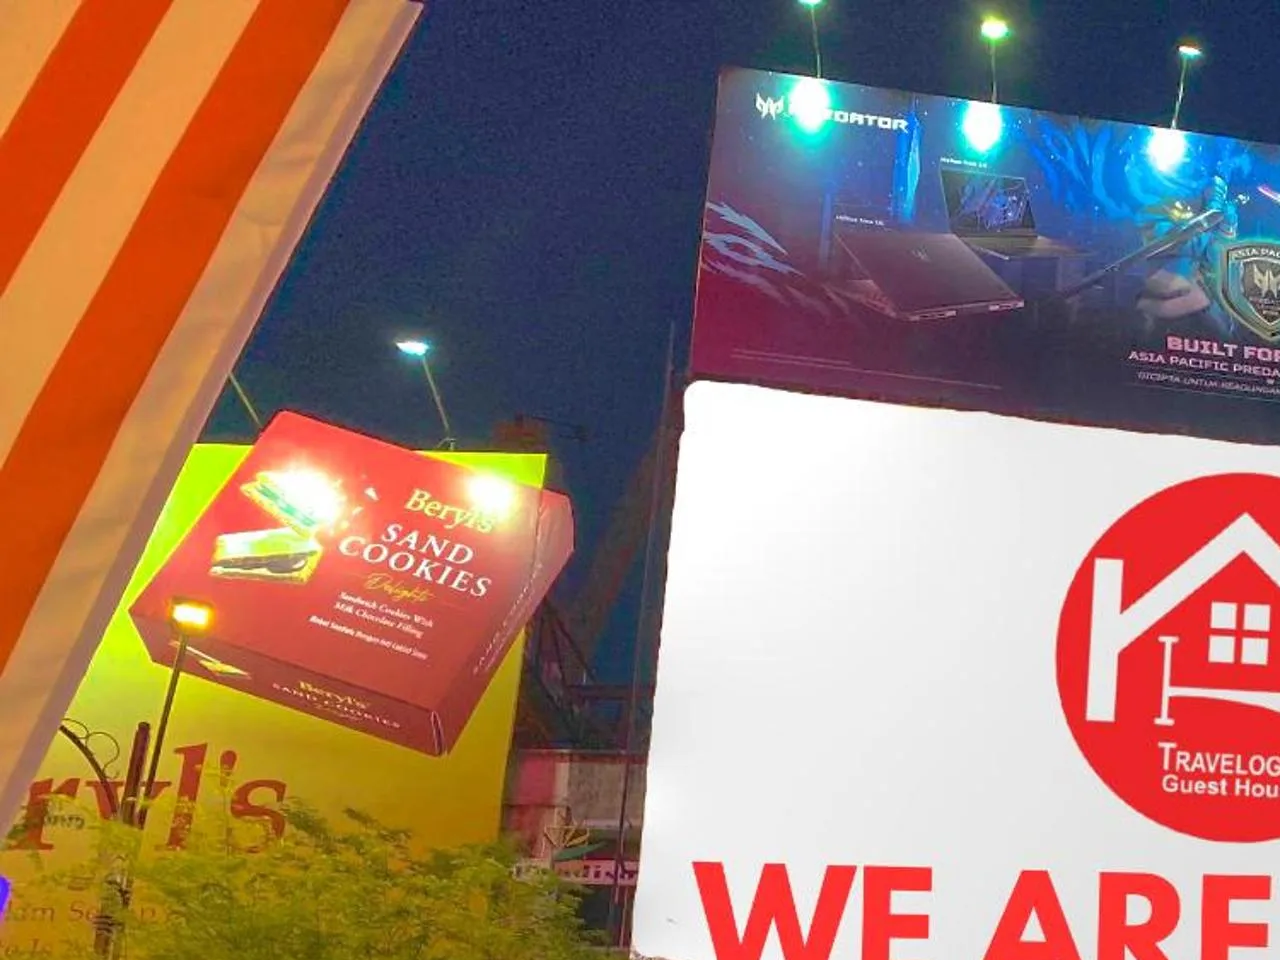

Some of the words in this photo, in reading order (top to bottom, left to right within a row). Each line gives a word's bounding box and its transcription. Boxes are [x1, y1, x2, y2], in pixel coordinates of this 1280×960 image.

[1128, 350, 1167, 364] ASIA
[1169, 355, 1229, 371] PACIFIC
[1166, 335, 1238, 358] BUILT
[380, 523, 475, 565] SAND
[338, 535, 493, 597] COOKIES
